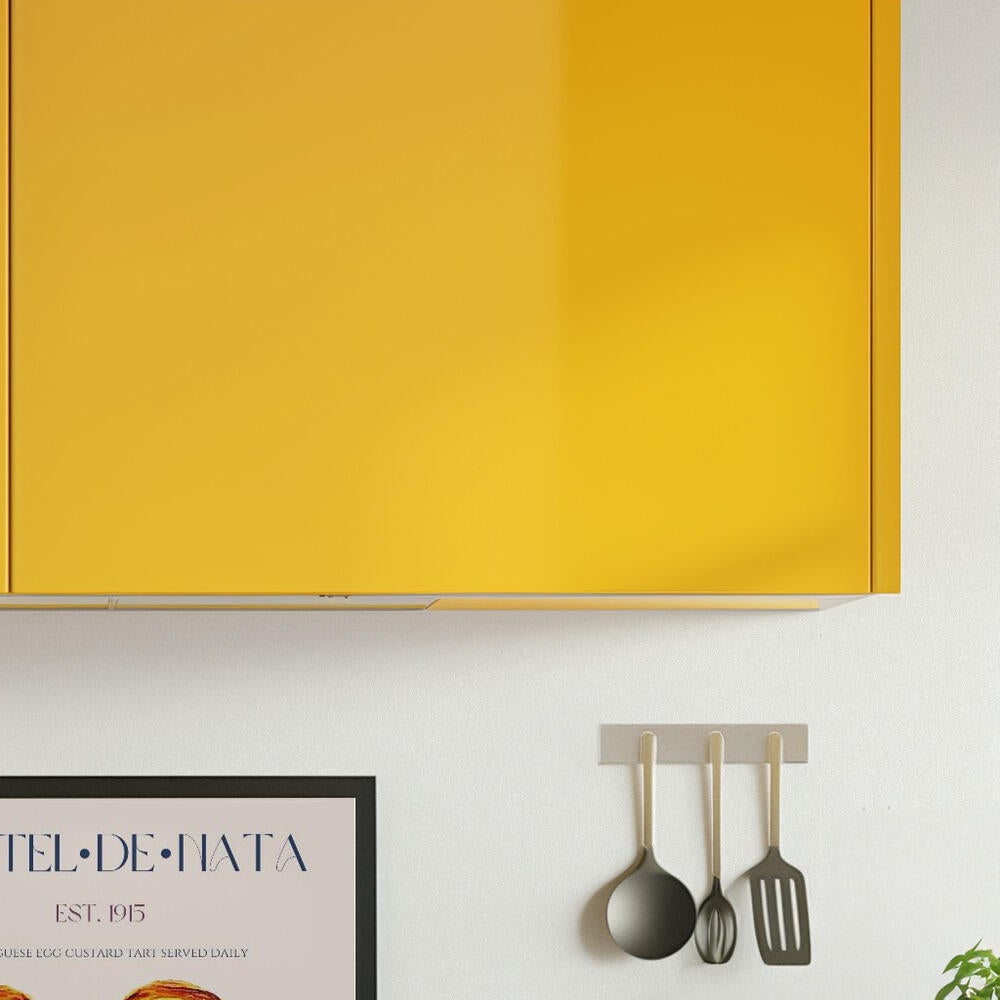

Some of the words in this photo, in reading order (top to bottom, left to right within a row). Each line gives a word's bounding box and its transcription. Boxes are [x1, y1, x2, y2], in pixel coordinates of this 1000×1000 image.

[55, 904, 102, 924] EST.
[109, 904, 146, 924] 1915
[36, 948, 62, 959] EGG
[64, 948, 124, 959] CUSTARD
[126, 948, 157, 959] TART
[160, 948, 209, 959] SERVED
[210, 948, 249, 959] DAILY
